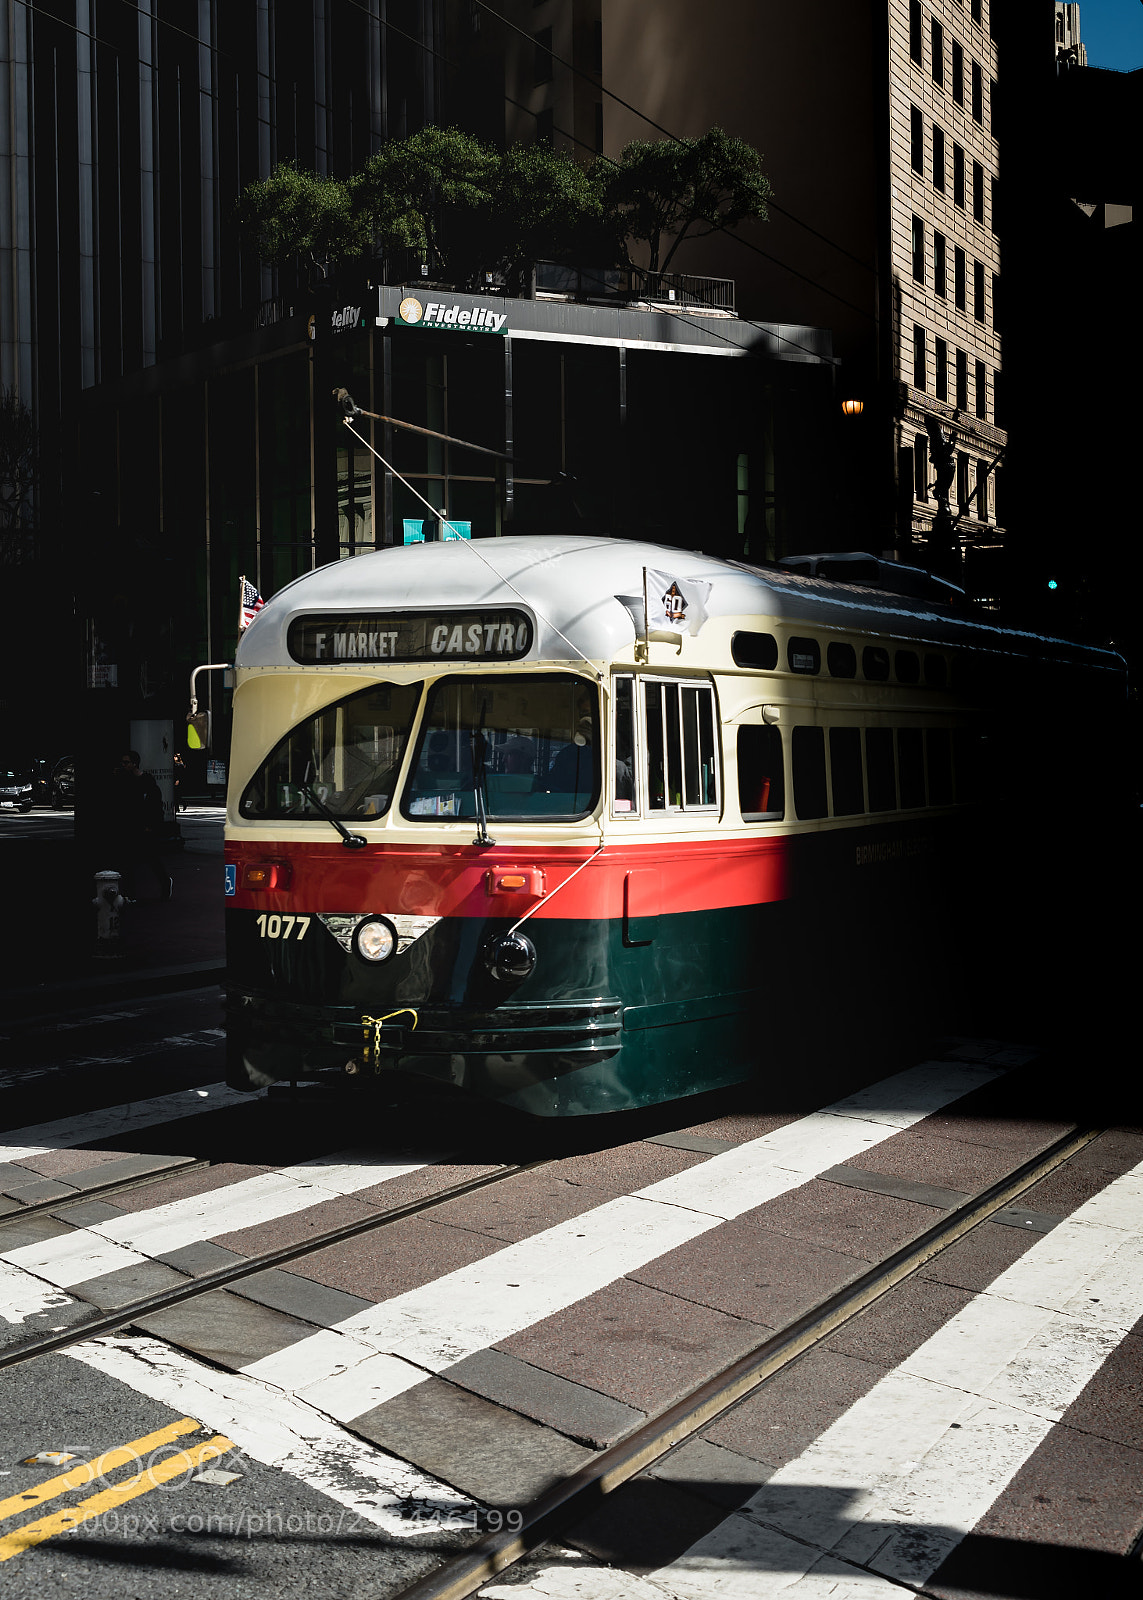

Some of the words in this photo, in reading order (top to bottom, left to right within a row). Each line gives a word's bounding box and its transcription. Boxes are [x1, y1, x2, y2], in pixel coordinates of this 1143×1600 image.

[422, 321, 491, 332] INVESTMENTS
[424, 303, 507, 332] Fidelity
[664, 593, 683, 613] 60
[315, 633, 326, 659] F
[333, 631, 398, 659] MARKET
[430, 623, 527, 654] CASTRO
[256, 914, 311, 940] 1077
